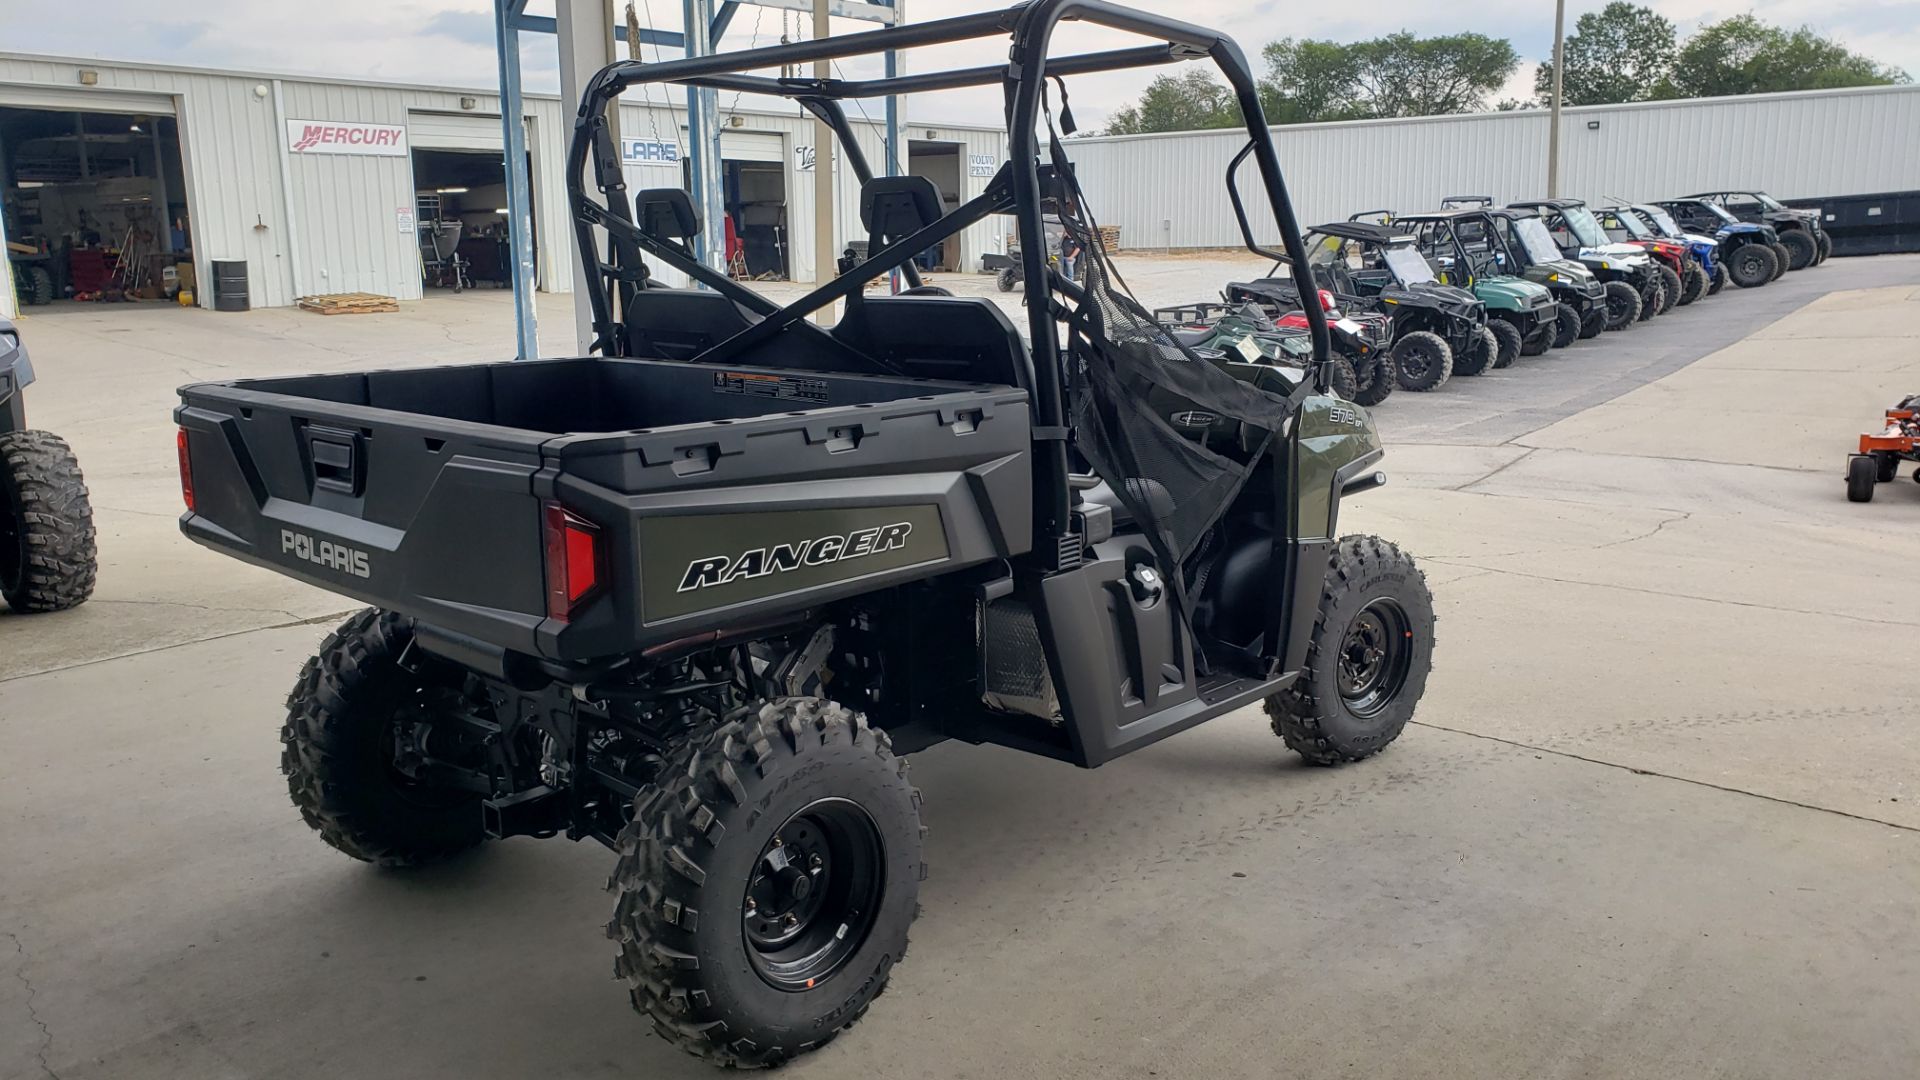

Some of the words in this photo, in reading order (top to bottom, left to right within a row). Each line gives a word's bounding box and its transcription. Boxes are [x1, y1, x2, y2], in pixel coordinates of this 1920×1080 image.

[295, 125, 402, 150] MERCURY
[622, 141, 677, 161] LARIS
[969, 155, 995, 165] VOLVO
[970, 166, 995, 176] PENTA
[1329, 406, 1355, 425] 570
[281, 528, 370, 579] POLARIS
[677, 521, 913, 593] RANGER
